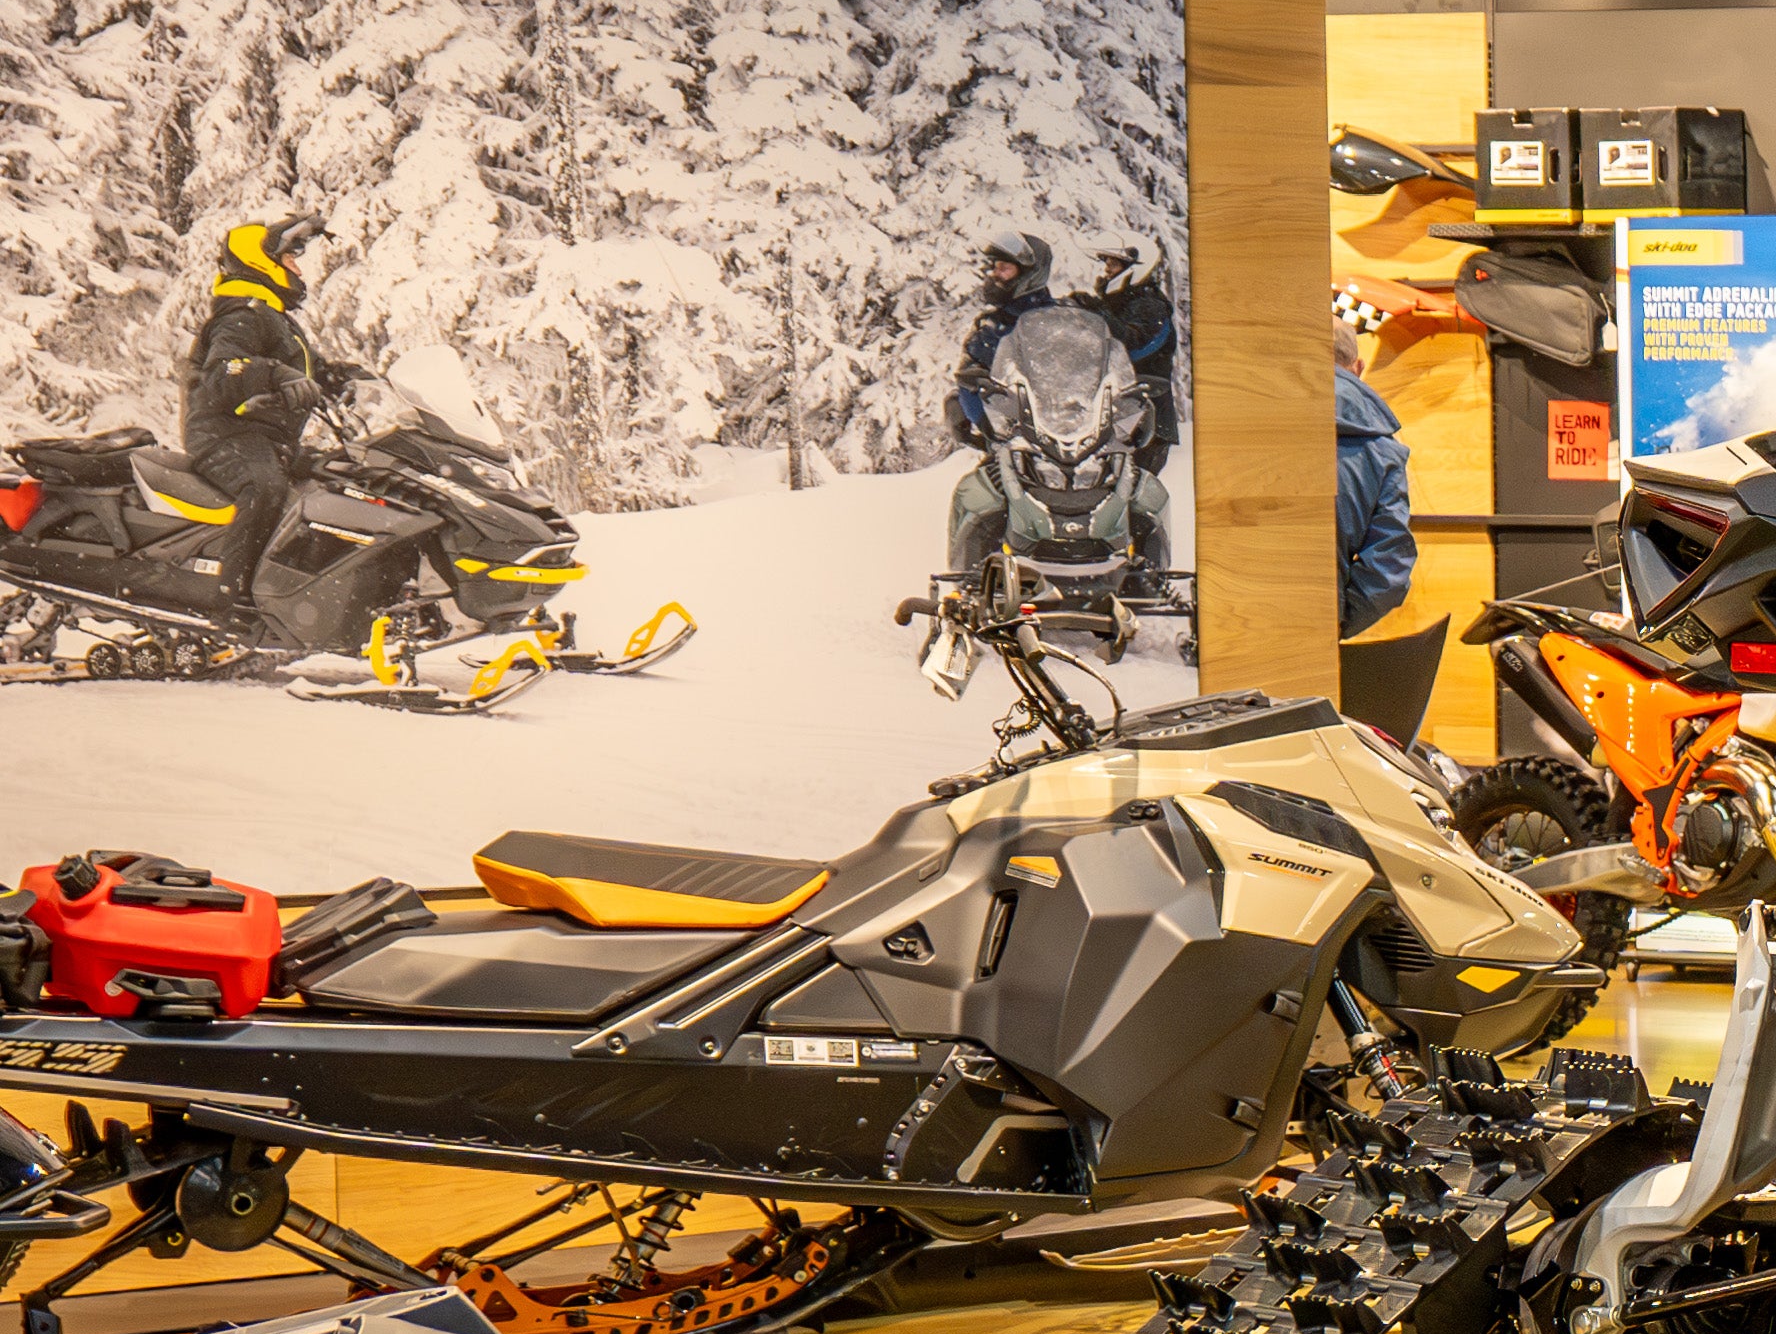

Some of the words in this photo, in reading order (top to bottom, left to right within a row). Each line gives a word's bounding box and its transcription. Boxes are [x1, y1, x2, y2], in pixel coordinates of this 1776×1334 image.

[1643, 241, 1699, 254] ski-doo
[1642, 286, 1700, 303] SUMMIT
[1643, 302, 1682, 318] WITH
[1685, 303, 1723, 319] EDGE
[1643, 318, 1701, 333] PREMIUM
[1703, 318, 1768, 334] FEATURES
[1643, 333, 1677, 347] WITH
[1679, 332, 1729, 348] PROVEN
[1554, 414, 1602, 430] LEARN
[1554, 430, 1576, 446] TO
[1554, 447, 1597, 467] RIDE
[1247, 852, 1333, 877] SUMMIT
